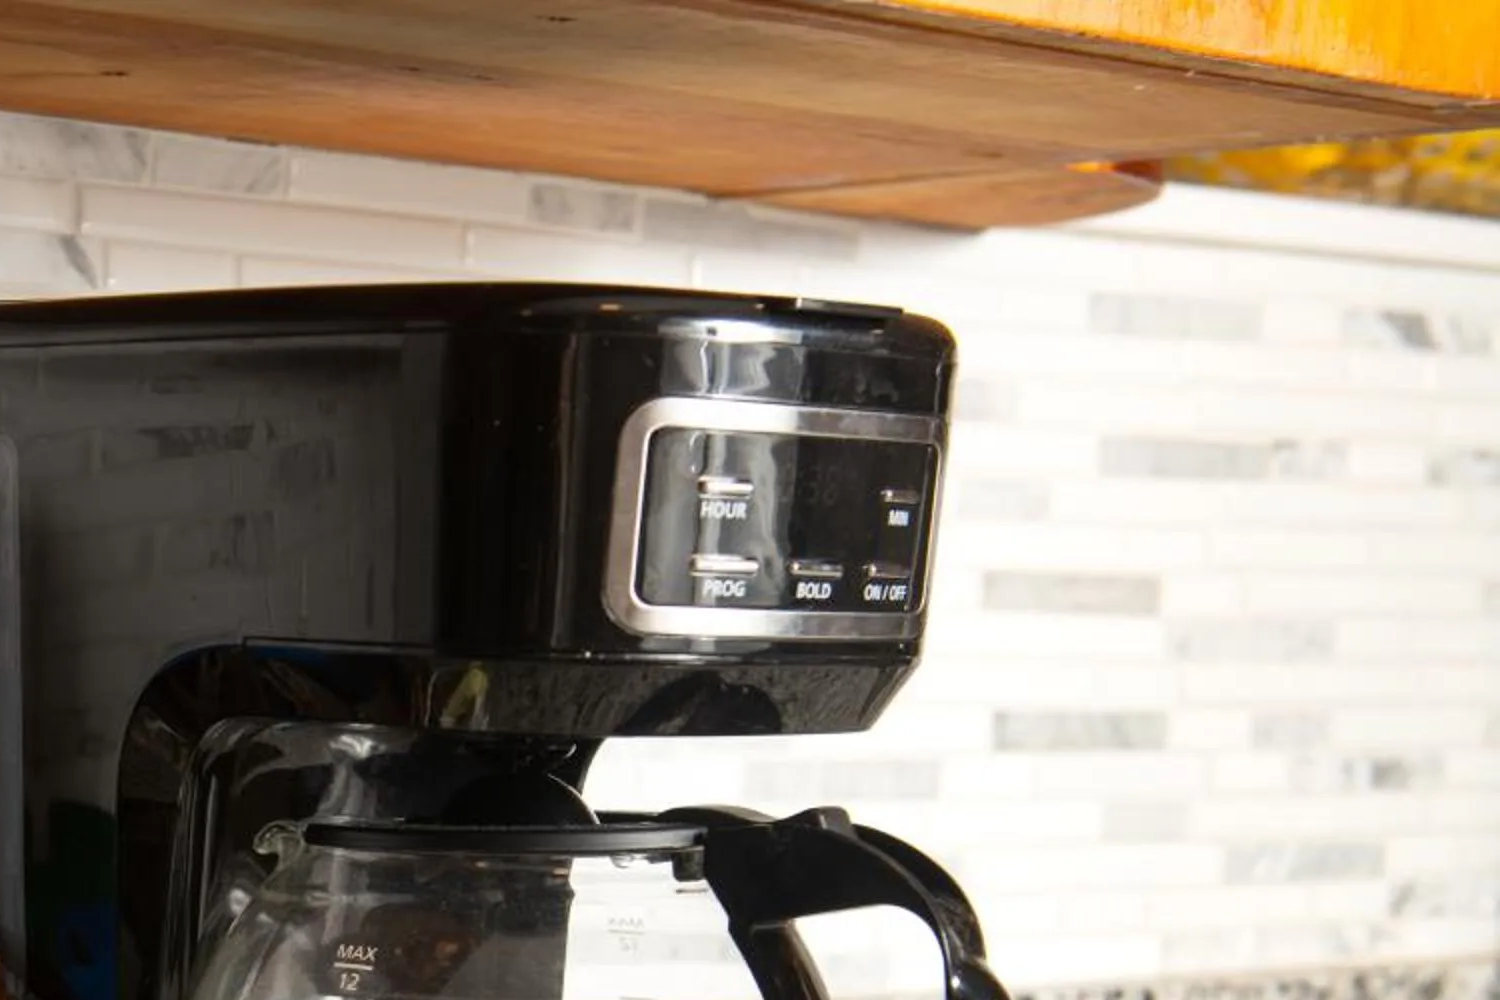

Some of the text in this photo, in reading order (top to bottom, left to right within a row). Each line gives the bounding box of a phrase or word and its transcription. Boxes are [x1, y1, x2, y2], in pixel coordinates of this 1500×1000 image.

[700, 500, 747, 519] HOUR
[702, 579, 747, 597] PROG
[795, 581, 832, 599] BOLD
[336, 943, 378, 961] MAX
[339, 972, 360, 991] 12
